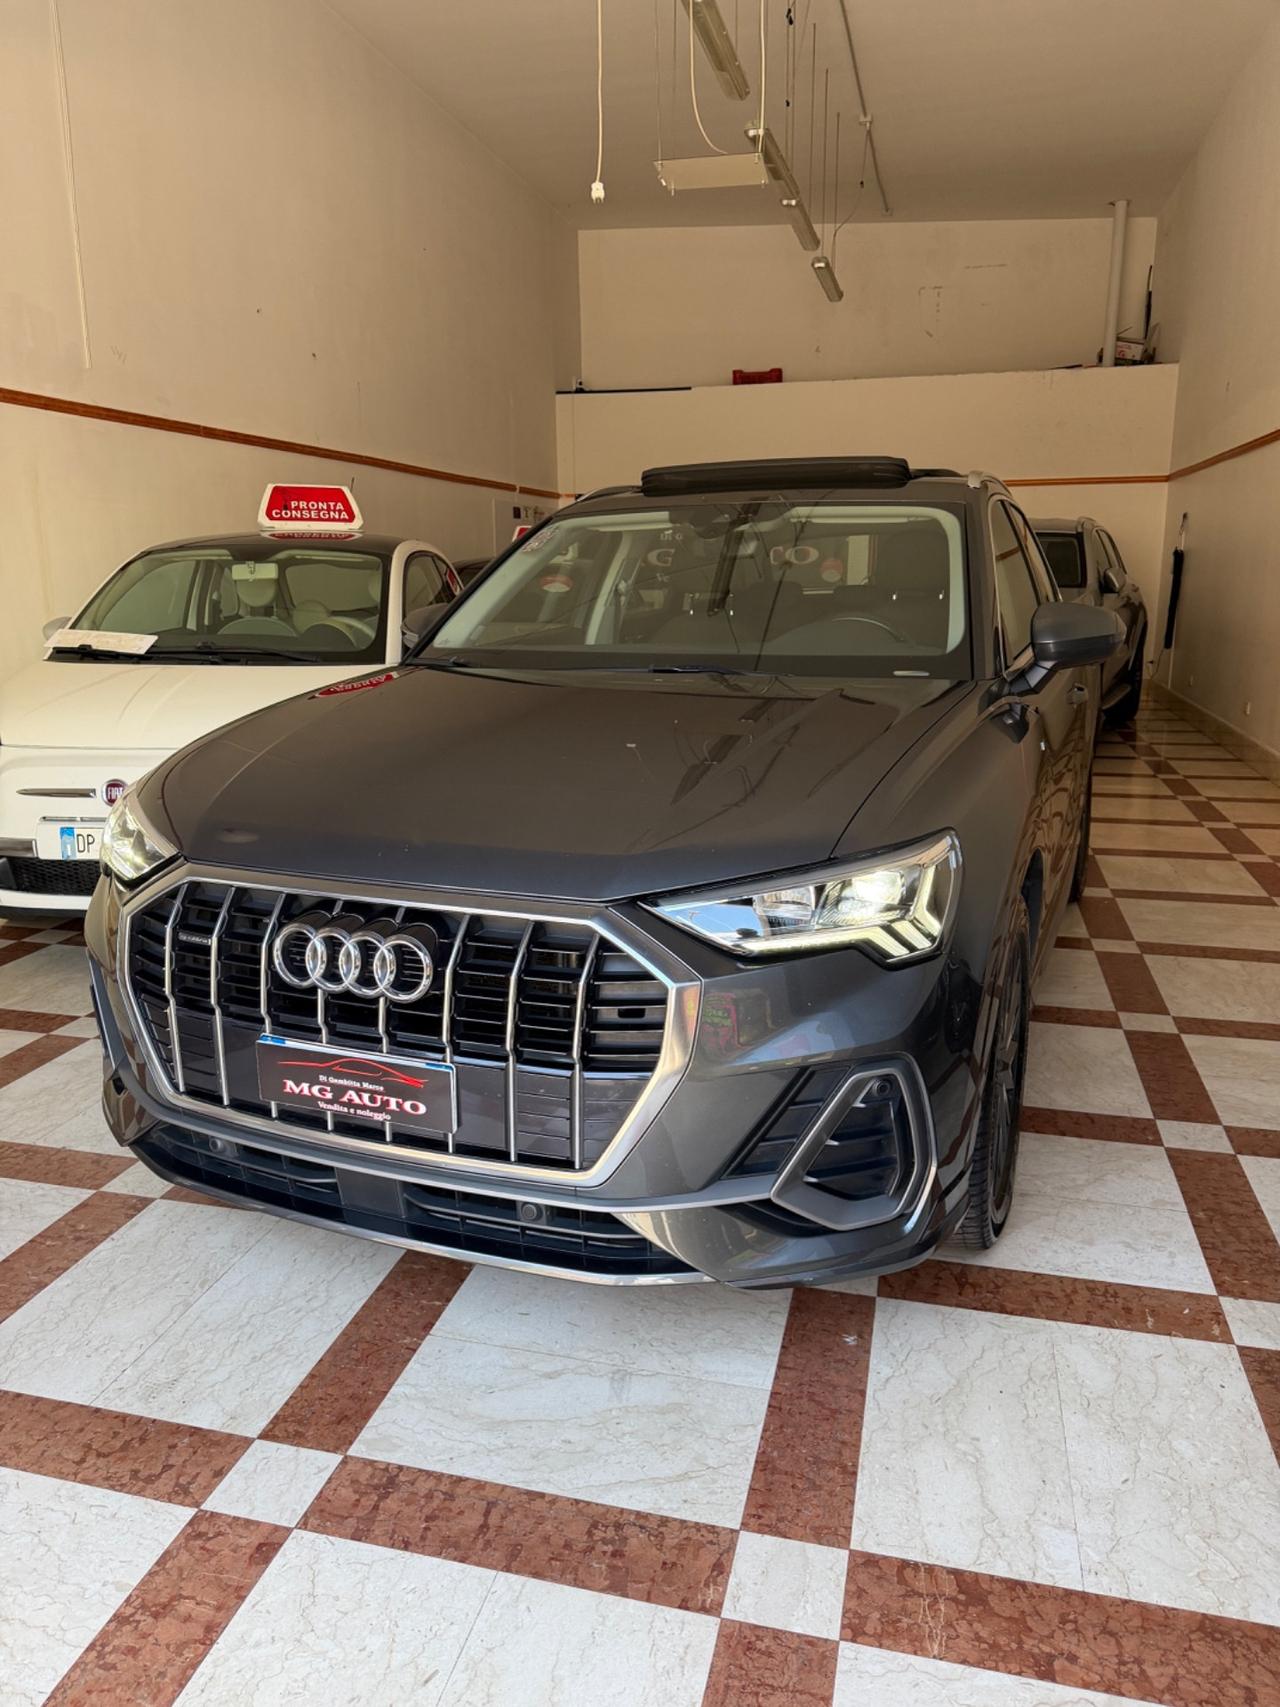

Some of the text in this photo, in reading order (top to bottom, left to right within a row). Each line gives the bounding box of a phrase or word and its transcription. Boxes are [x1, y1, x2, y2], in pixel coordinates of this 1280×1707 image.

[272, 509, 349, 519] CONSEGNA
[291, 501, 344, 511] PRONTA
[76, 833, 95, 853] DP
[283, 1079, 427, 1115] MG AUTO
[317, 1101, 348, 1113] Vendita
[356, 1107, 392, 1121] noleggio
